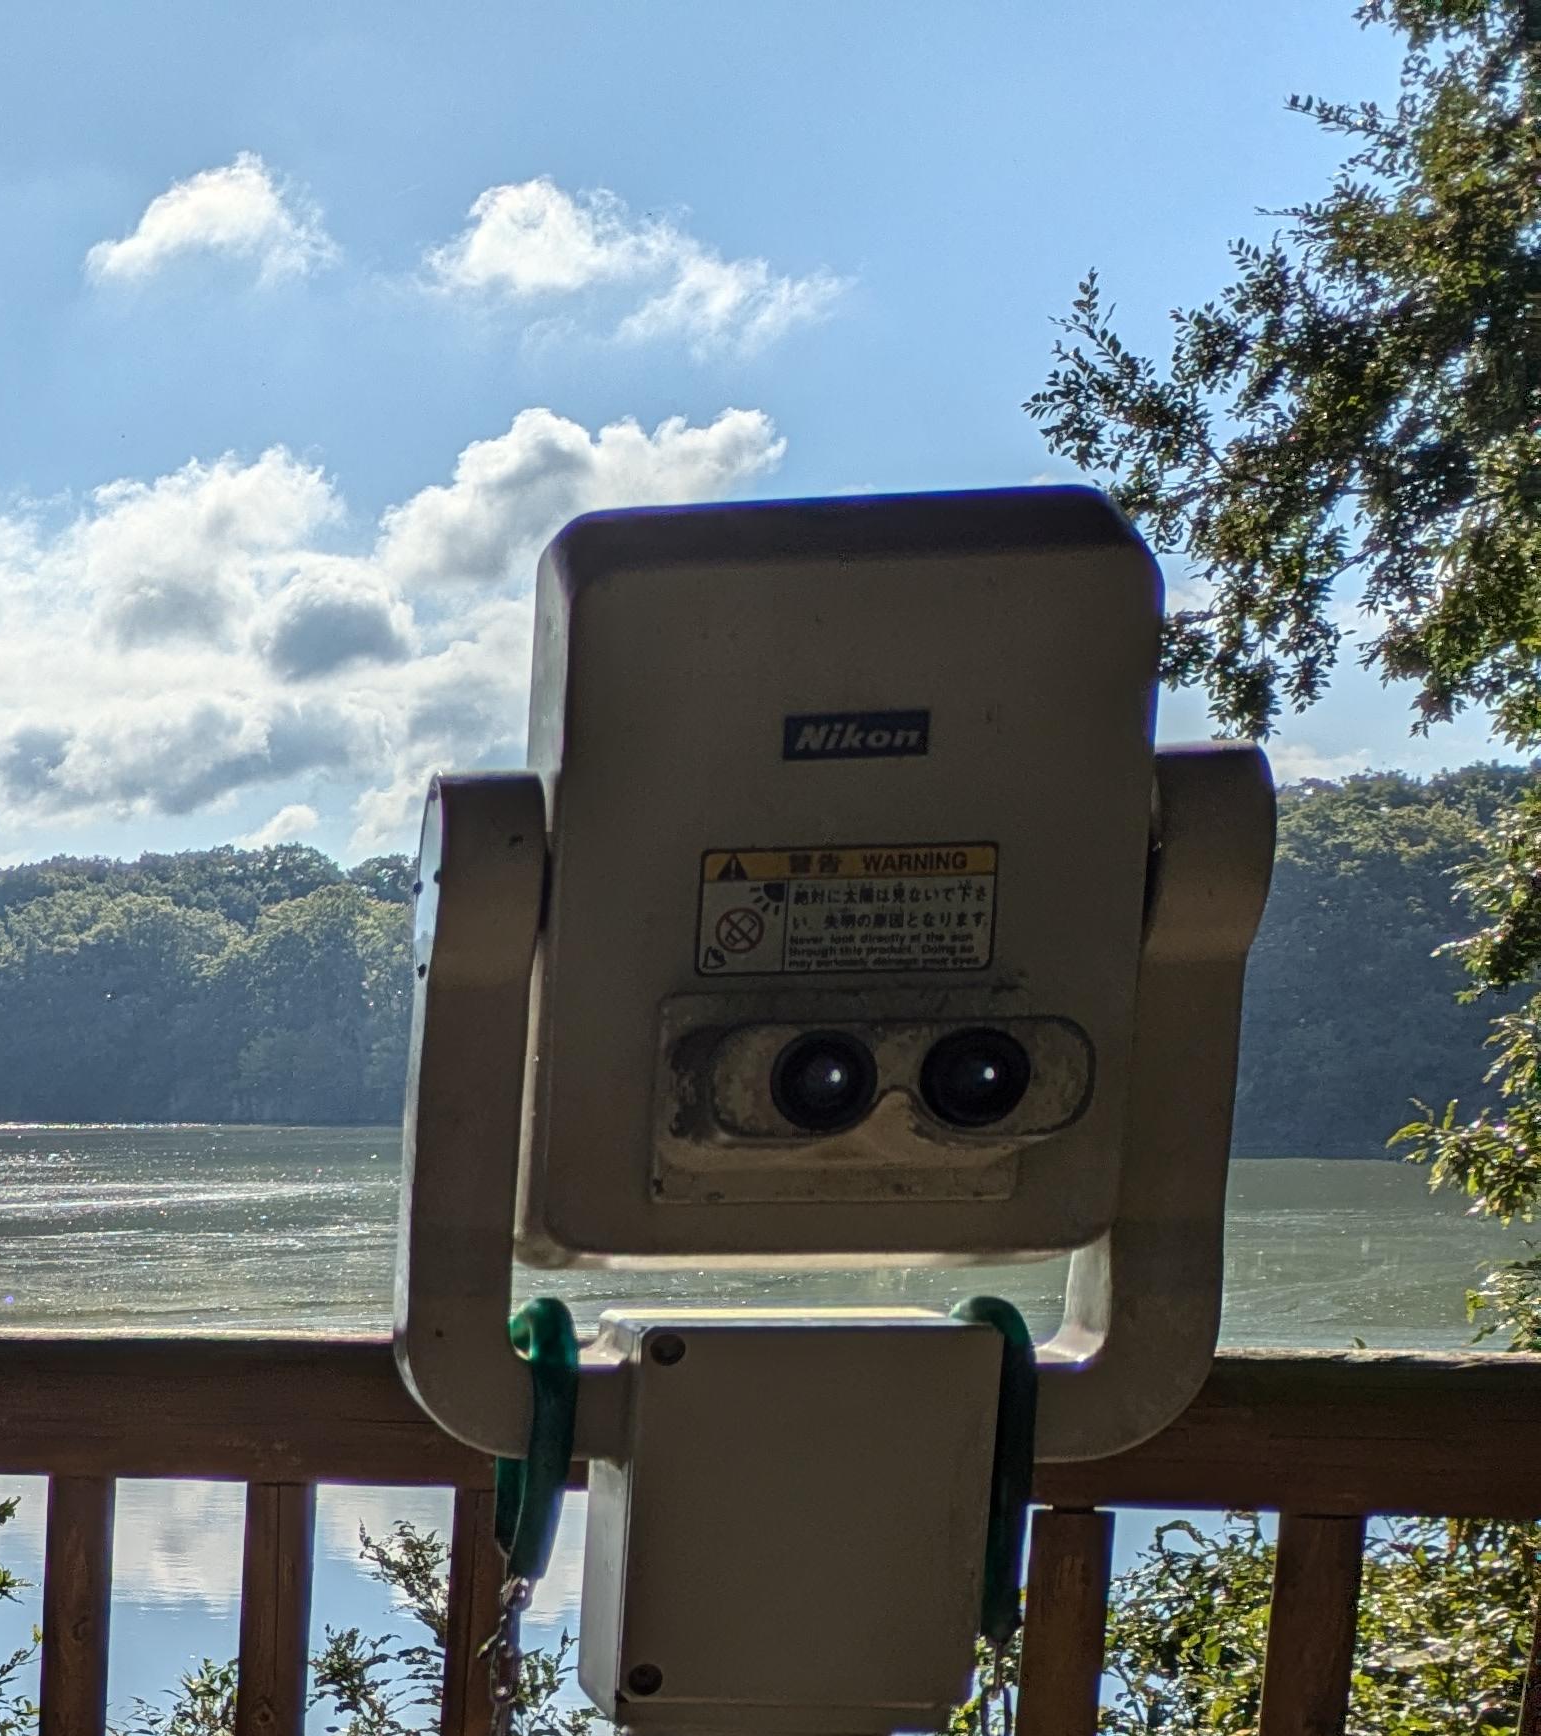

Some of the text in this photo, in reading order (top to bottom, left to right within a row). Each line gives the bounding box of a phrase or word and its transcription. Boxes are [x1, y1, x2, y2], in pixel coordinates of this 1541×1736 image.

[794, 722, 921, 751] Nikon
[863, 851, 968, 871] WARNING
[926, 932, 945, 942] the
[789, 945, 836, 957] through
[840, 945, 862, 955] this
